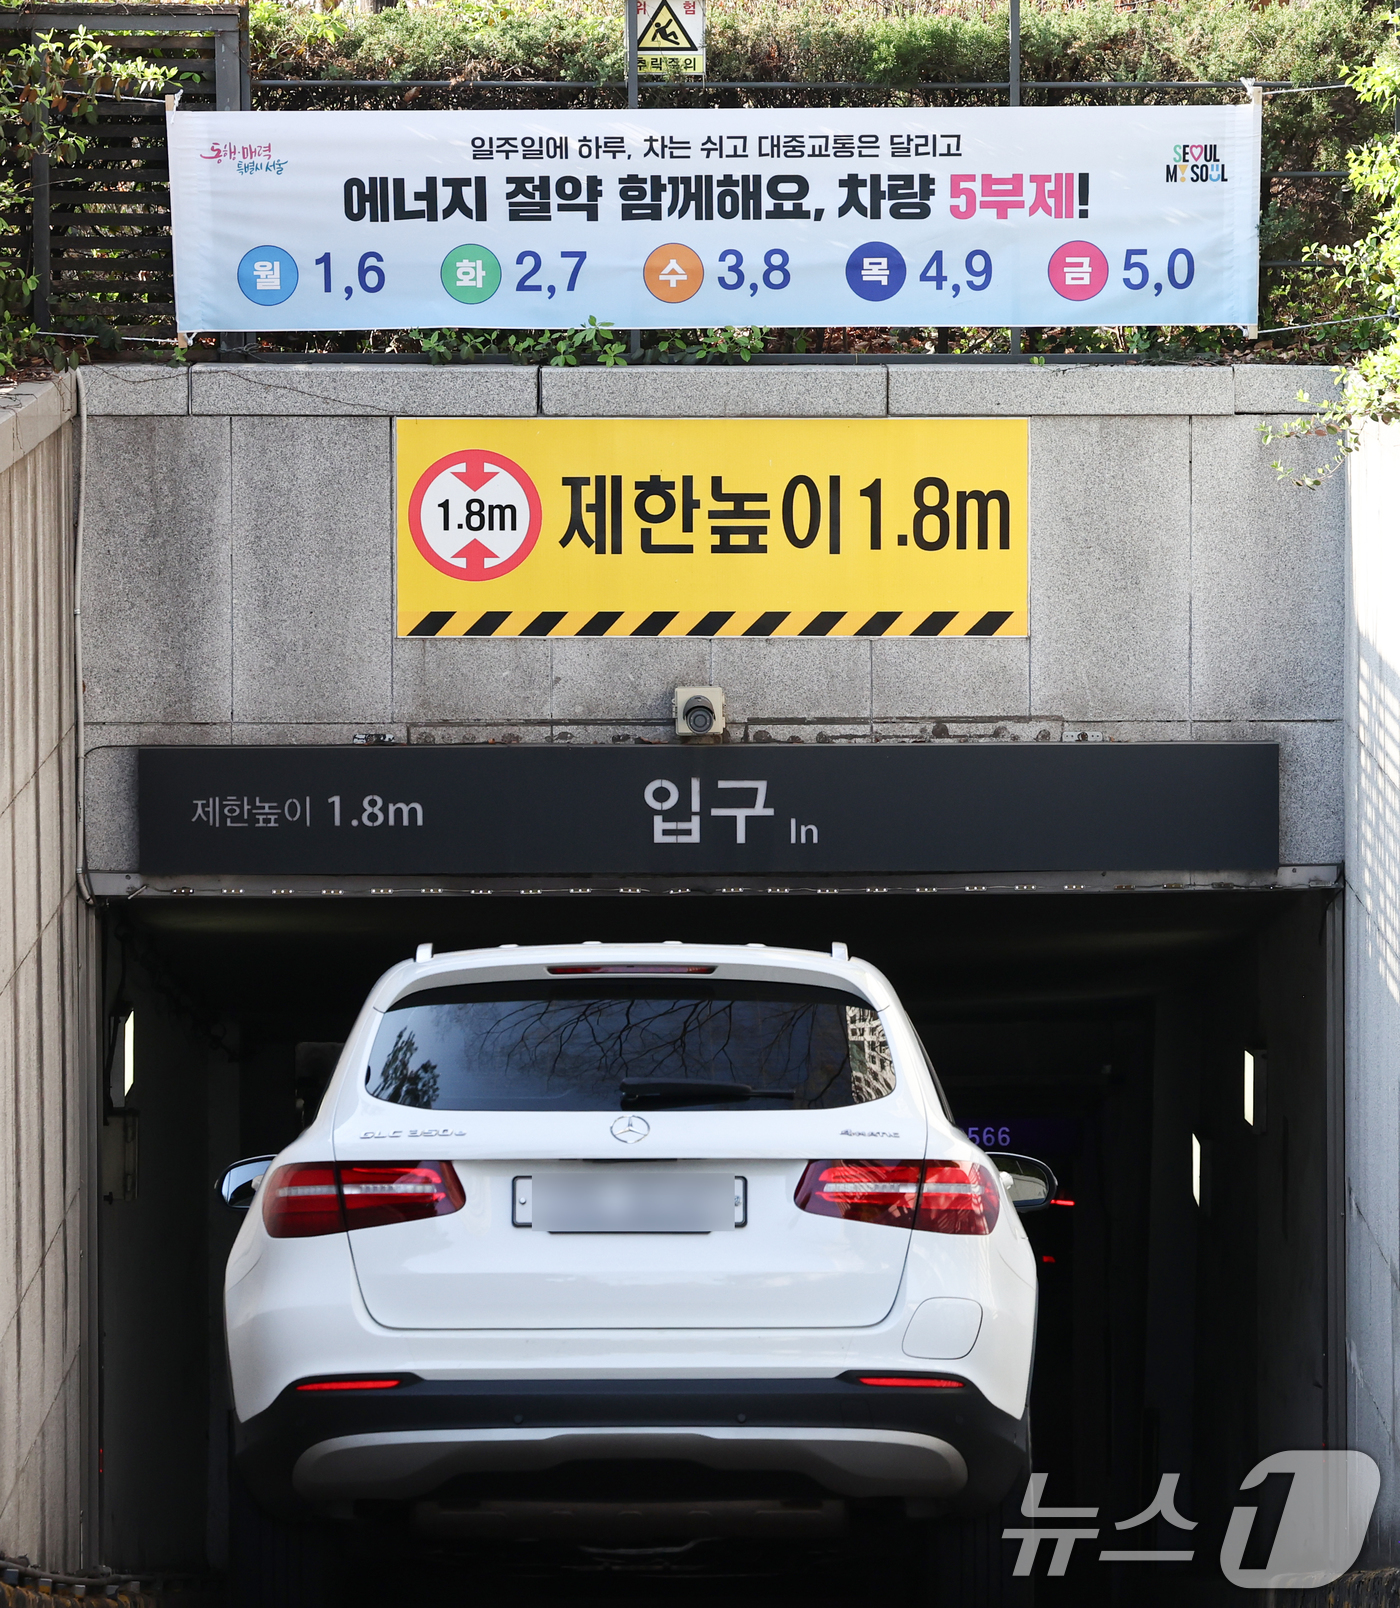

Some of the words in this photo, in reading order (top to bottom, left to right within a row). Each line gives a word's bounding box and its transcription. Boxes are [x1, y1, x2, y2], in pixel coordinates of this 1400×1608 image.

[237, 160, 263, 175] 특별시
[265, 159, 289, 175] 서울
[470, 136, 569, 160] 일주일에
[577, 135, 632, 160] 하루,
[643, 135, 692, 159] 차는
[700, 135, 749, 159] 쉬고
[758, 134, 881, 159] 대중교통은
[890, 134, 962, 158] 달리고
[343, 175, 488, 223] 에너지
[505, 174, 603, 222] 절약
[618, 173, 825, 222] 함께해요,
[837, 173, 936, 220] 차량
[949, 172, 1090, 220] 5부제!
[253, 261, 282, 290] 월
[315, 251, 386, 301] 1,6
[456, 259, 487, 288] 화
[515, 250, 588, 300] 2,7
[658, 259, 689, 288] 수
[717, 248, 791, 298] 3,8
[860, 257, 890, 286] 목
[919, 249, 993, 299] 4,9
[1063, 257, 1093, 286] 금
[1122, 247, 1195, 298] 5,0
[437, 498, 517, 532] 1.8m
[191, 796, 311, 828] 제한높이
[327, 794, 424, 828] 1.8m
[643, 777, 776, 845] 입구
[790, 816, 819, 845] In
[958, 1126, 1011, 1147] 566
